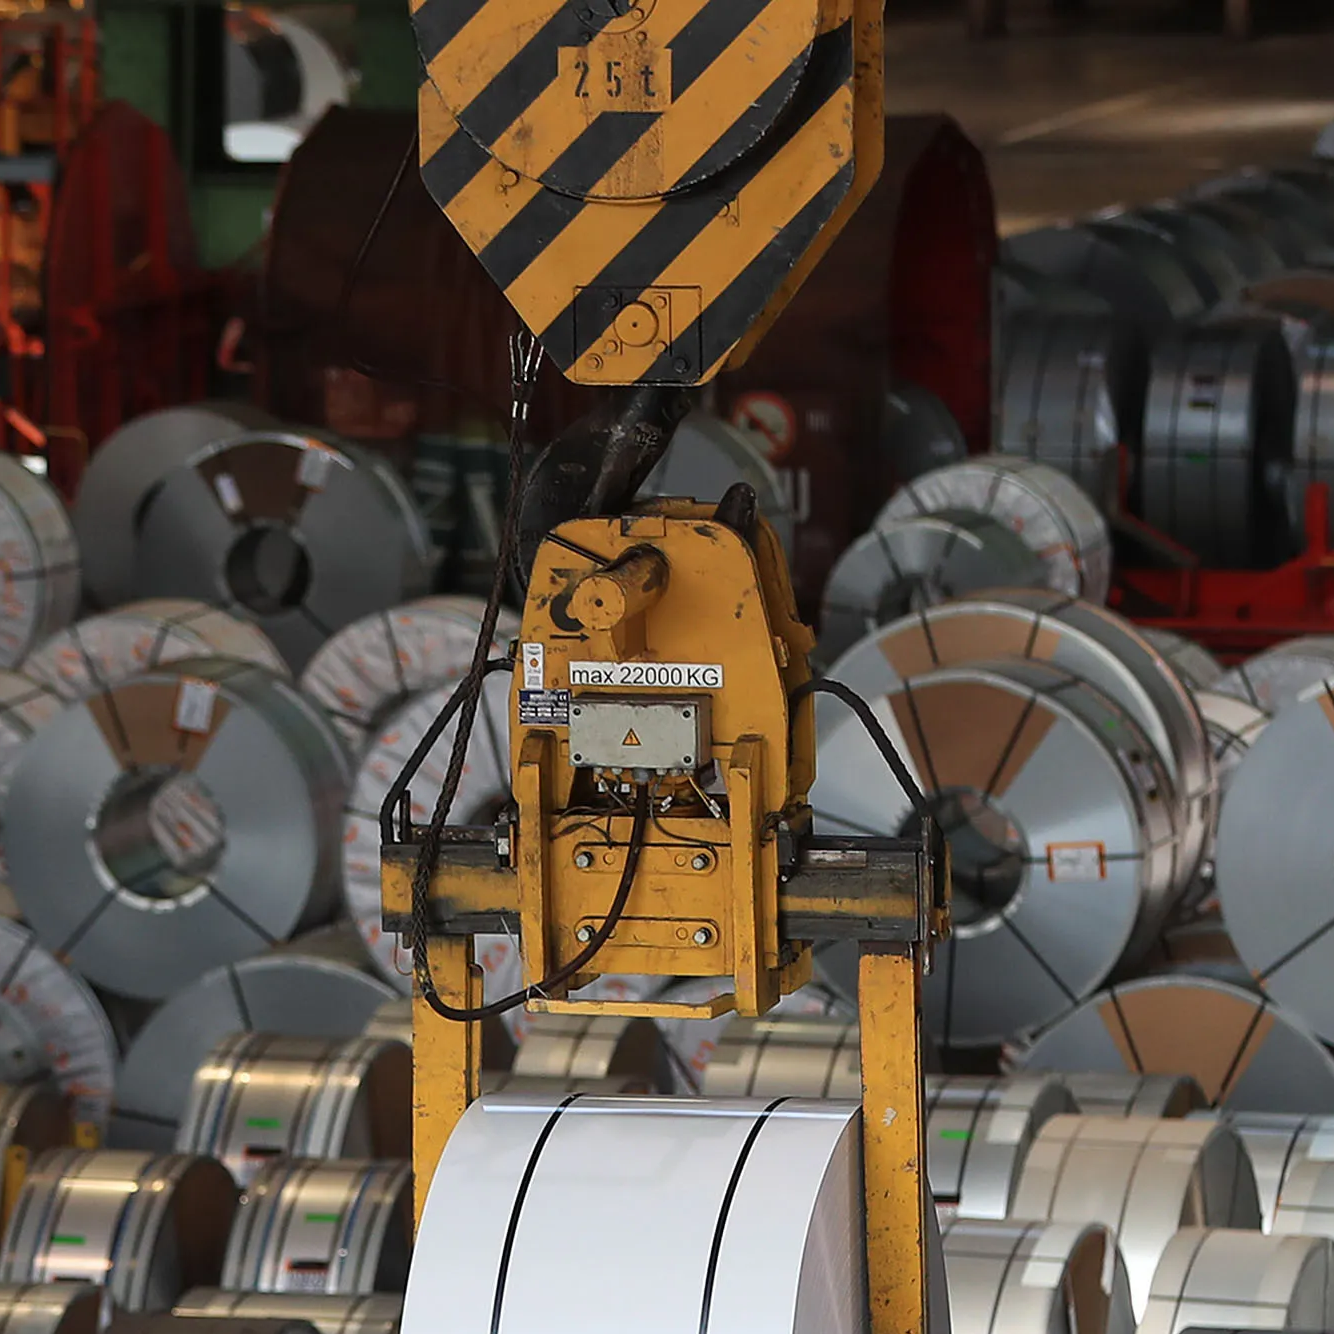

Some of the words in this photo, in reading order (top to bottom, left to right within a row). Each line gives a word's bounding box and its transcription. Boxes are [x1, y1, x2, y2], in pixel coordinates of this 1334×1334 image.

[574, 61, 622, 98] 25
[640, 65, 656, 97] t
[572, 668, 614, 684] max
[620, 666, 682, 686] 22000
[687, 667, 719, 686] KG
